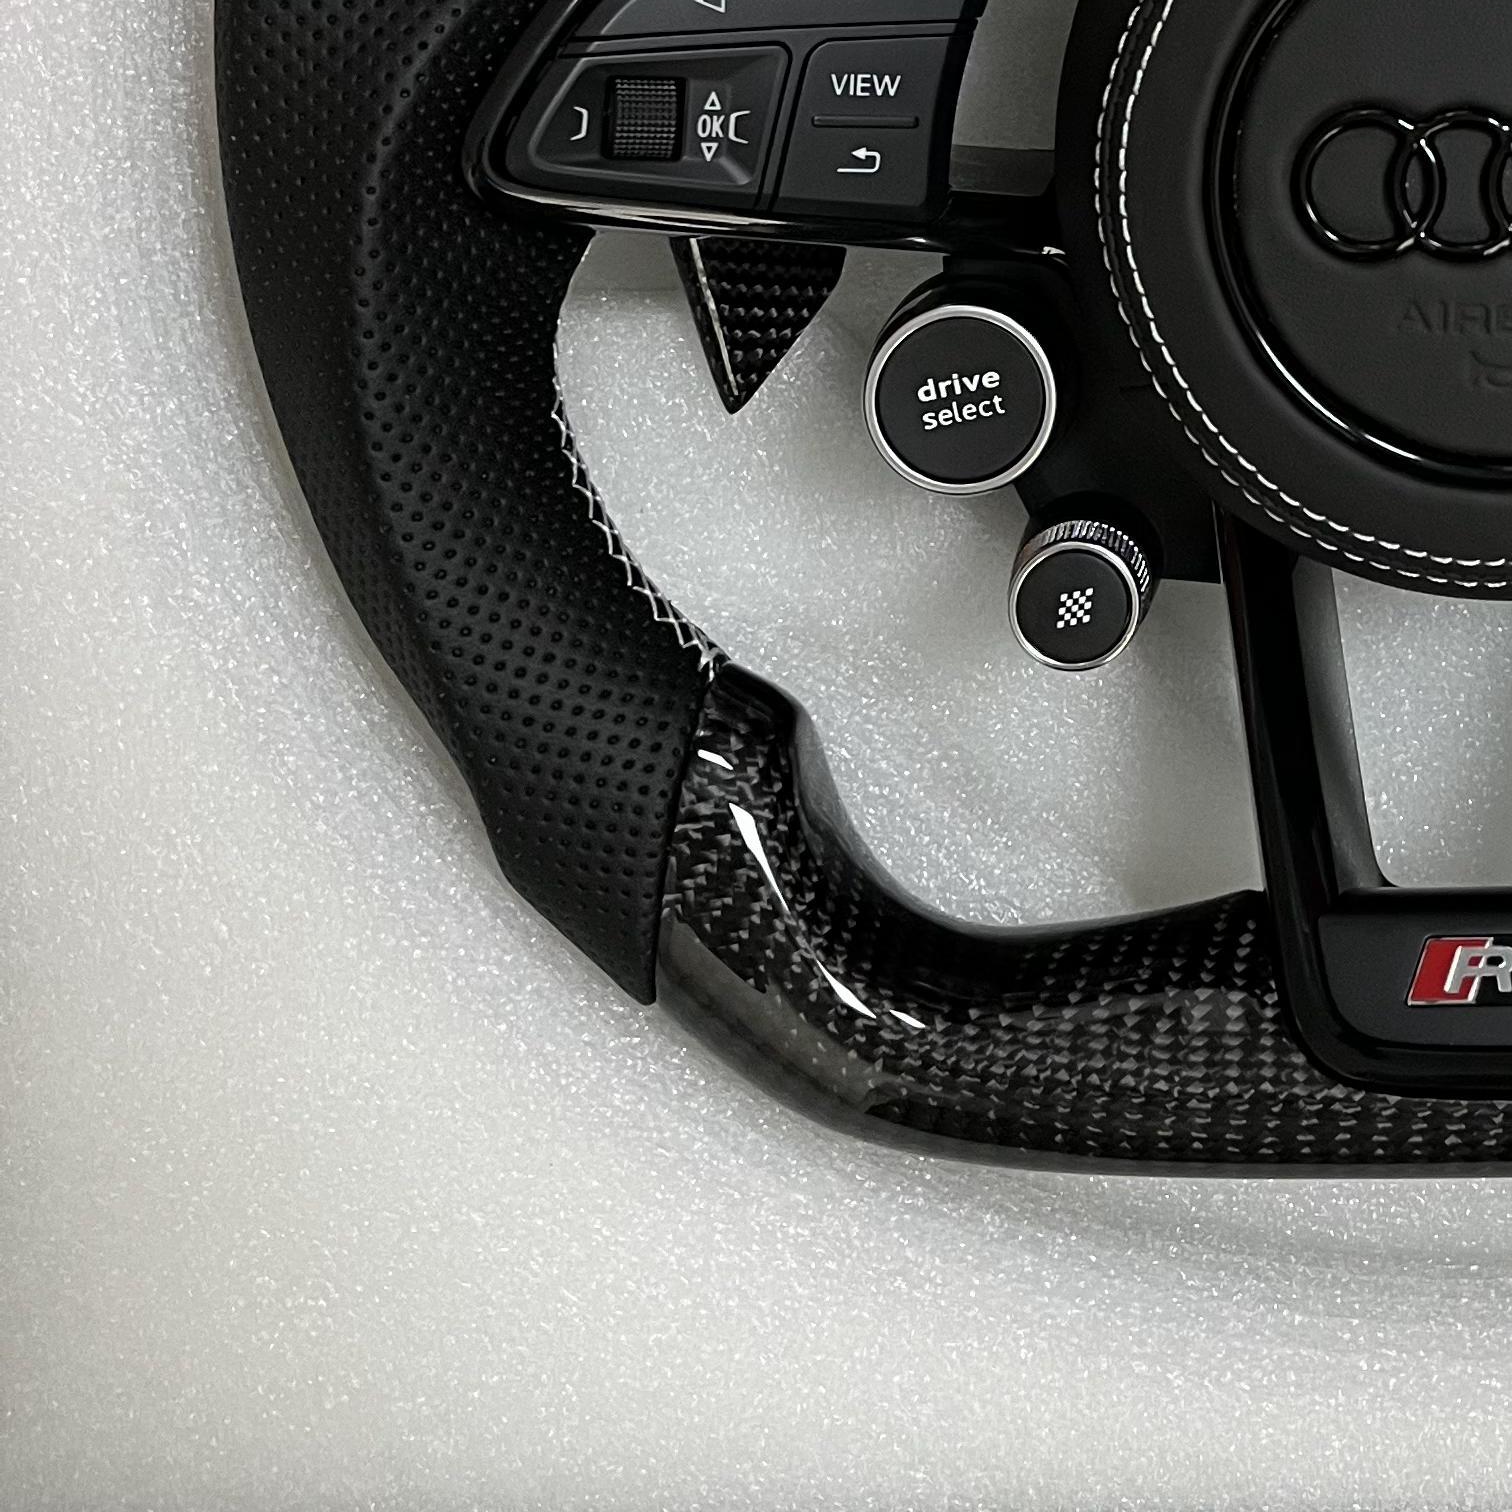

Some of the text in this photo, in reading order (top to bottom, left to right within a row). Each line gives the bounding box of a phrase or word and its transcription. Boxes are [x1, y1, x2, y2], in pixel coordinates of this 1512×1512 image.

[830, 73, 901, 97] VIEW
[697, 114, 724, 138] OK
[917, 371, 1000, 402] drive
[922, 395, 1005, 430] select
